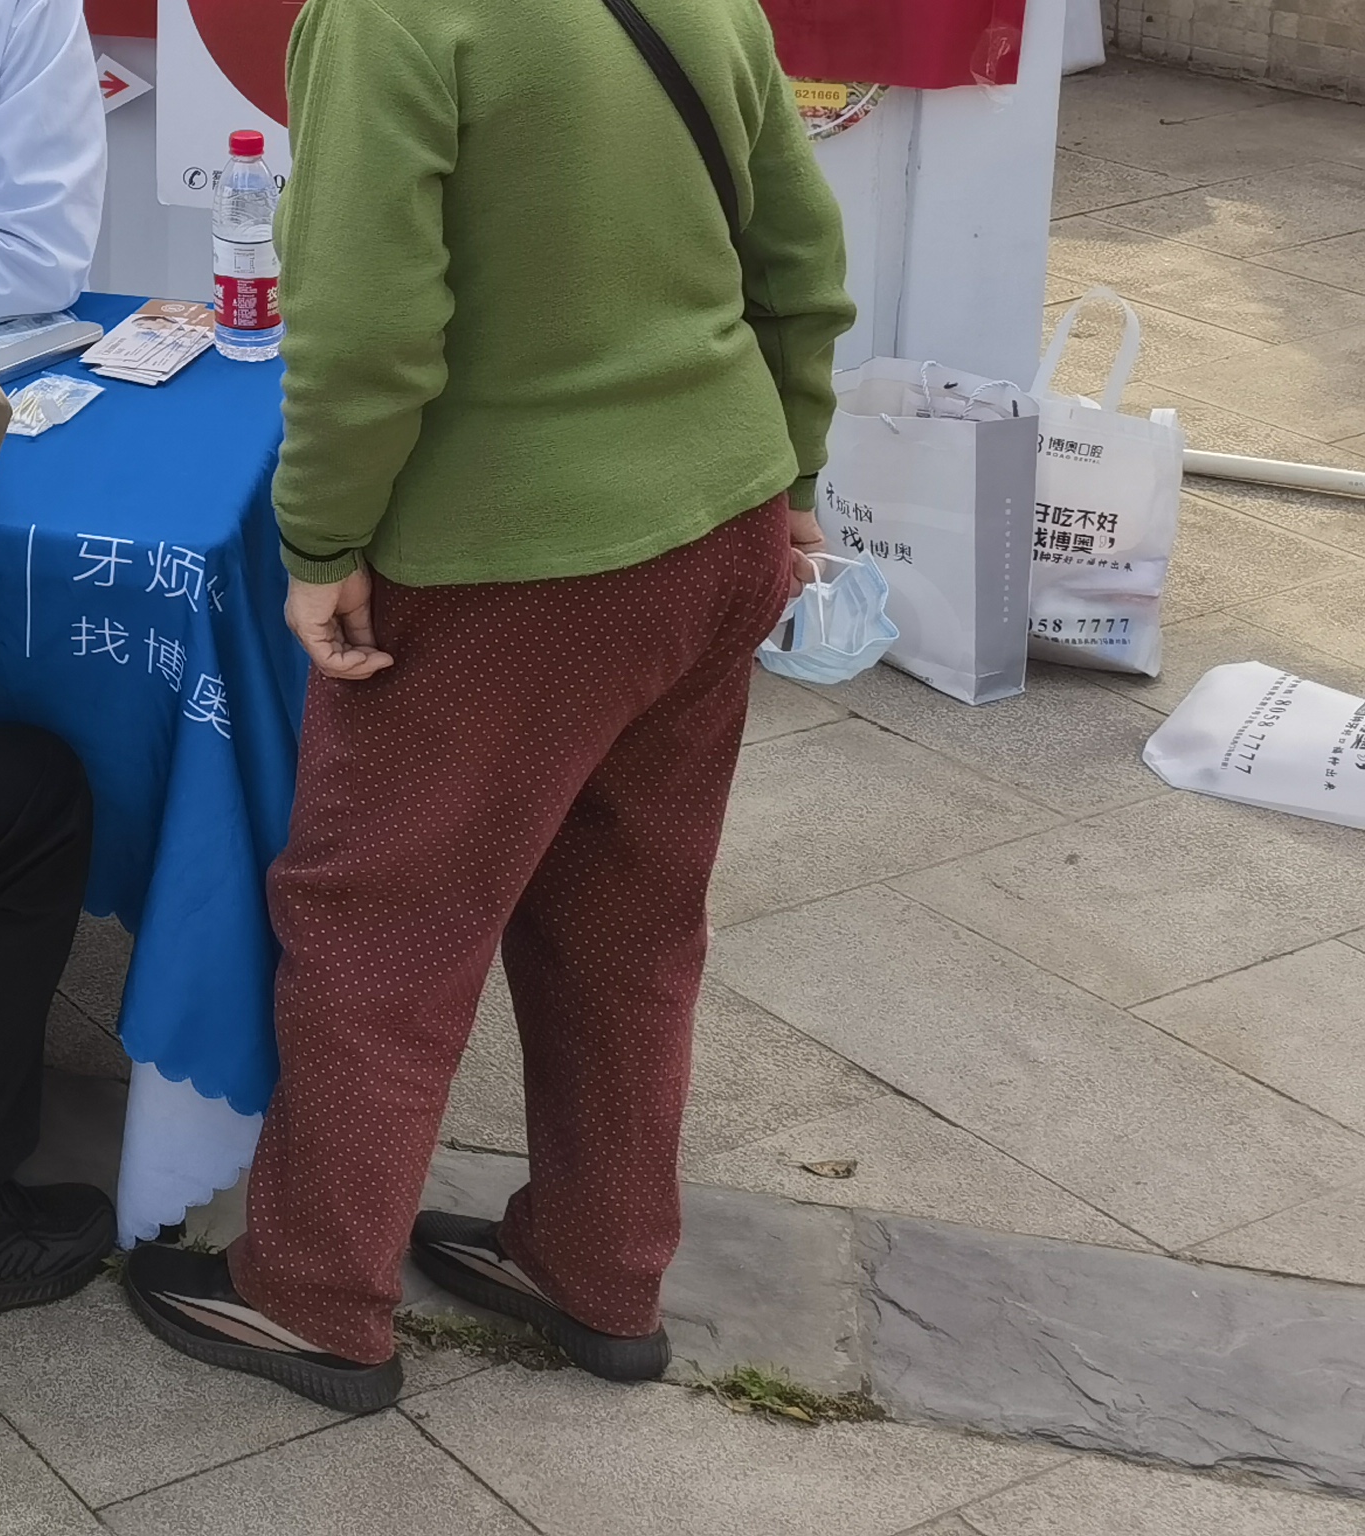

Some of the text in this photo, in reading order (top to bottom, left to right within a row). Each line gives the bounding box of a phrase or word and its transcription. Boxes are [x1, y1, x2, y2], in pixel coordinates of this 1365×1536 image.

[841, 526, 913, 565] 找博奥
[1076, 618, 1130, 633] 7777
[71, 616, 231, 740] 找博奥
[1257, 699, 1292, 728] 8058
[1234, 733, 1266, 775] 7777
